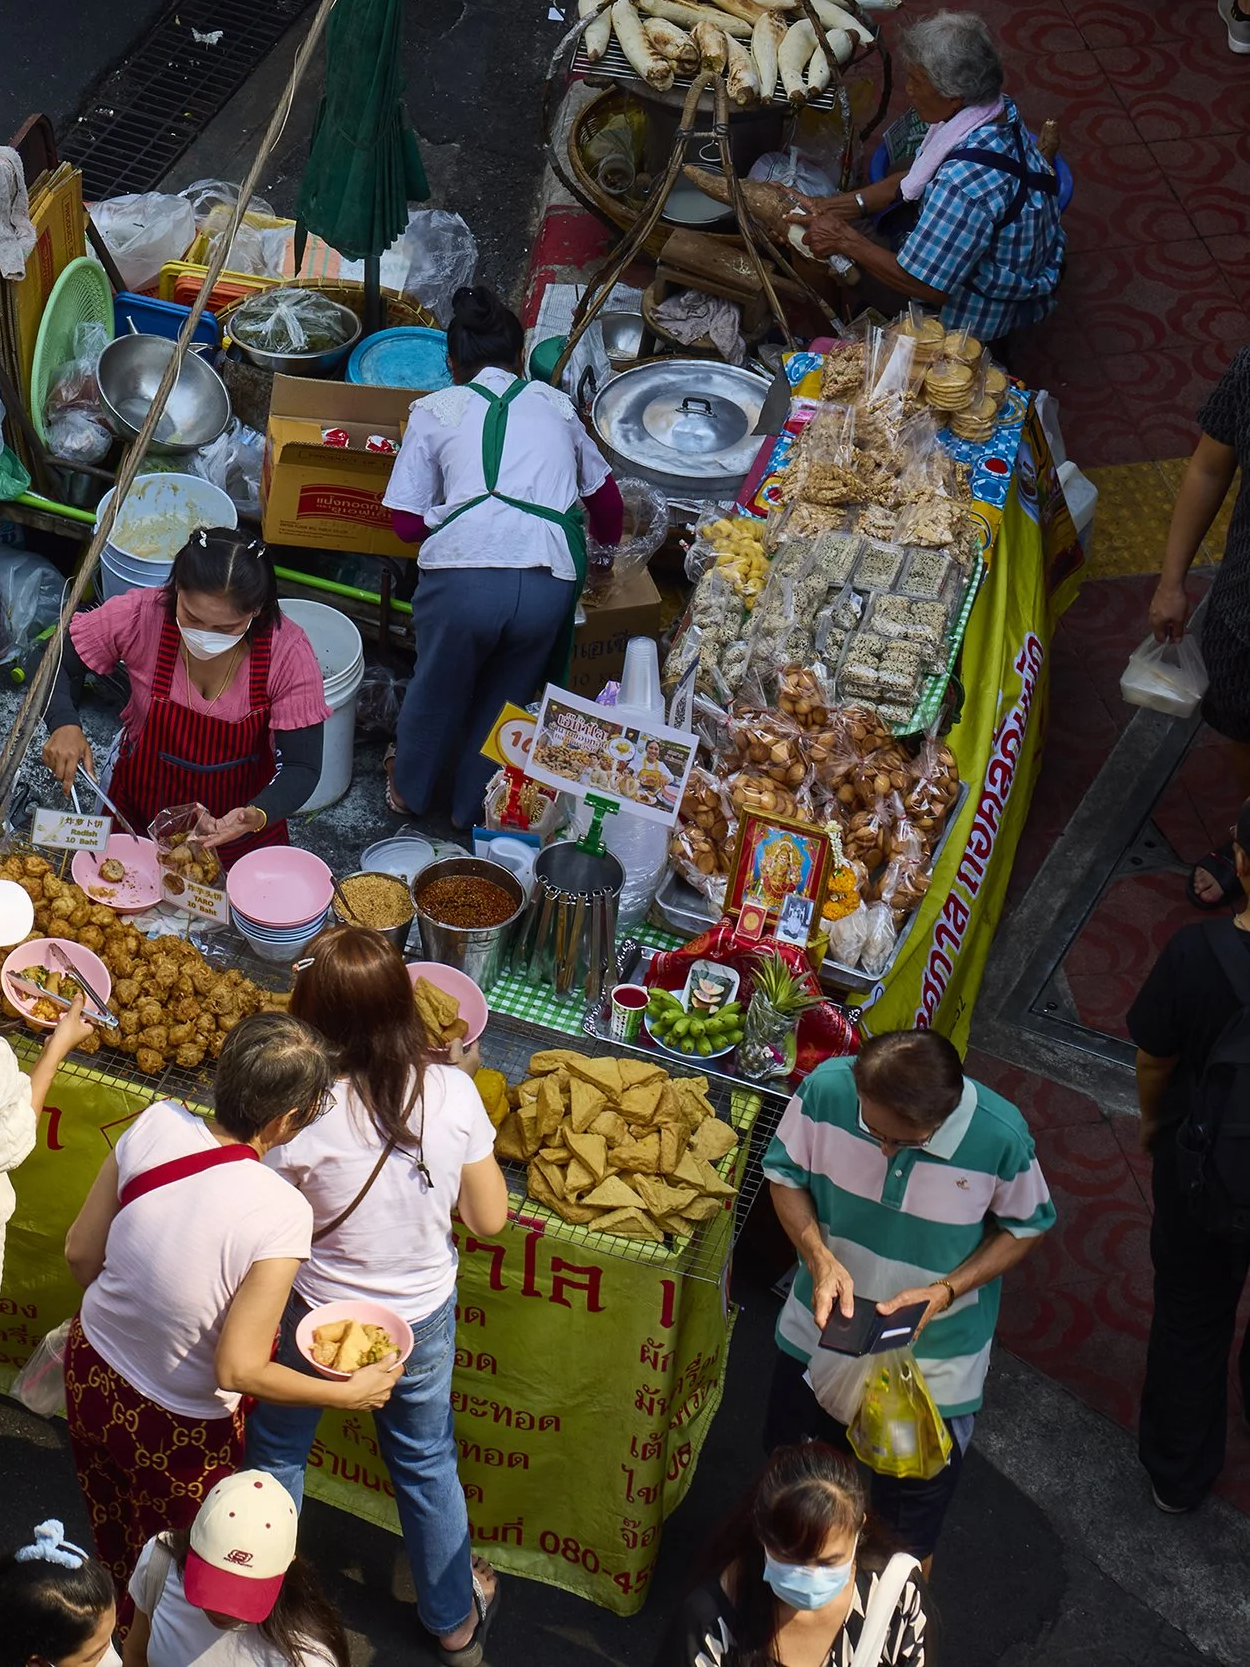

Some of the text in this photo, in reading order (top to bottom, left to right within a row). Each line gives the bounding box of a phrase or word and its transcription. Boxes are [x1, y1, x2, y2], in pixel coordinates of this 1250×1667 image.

[70, 828, 98, 837] Radish
[64, 836, 99, 846] 10 Baht
[193, 894, 214, 907] TARO
[186, 899, 218, 917] 10 Baht
